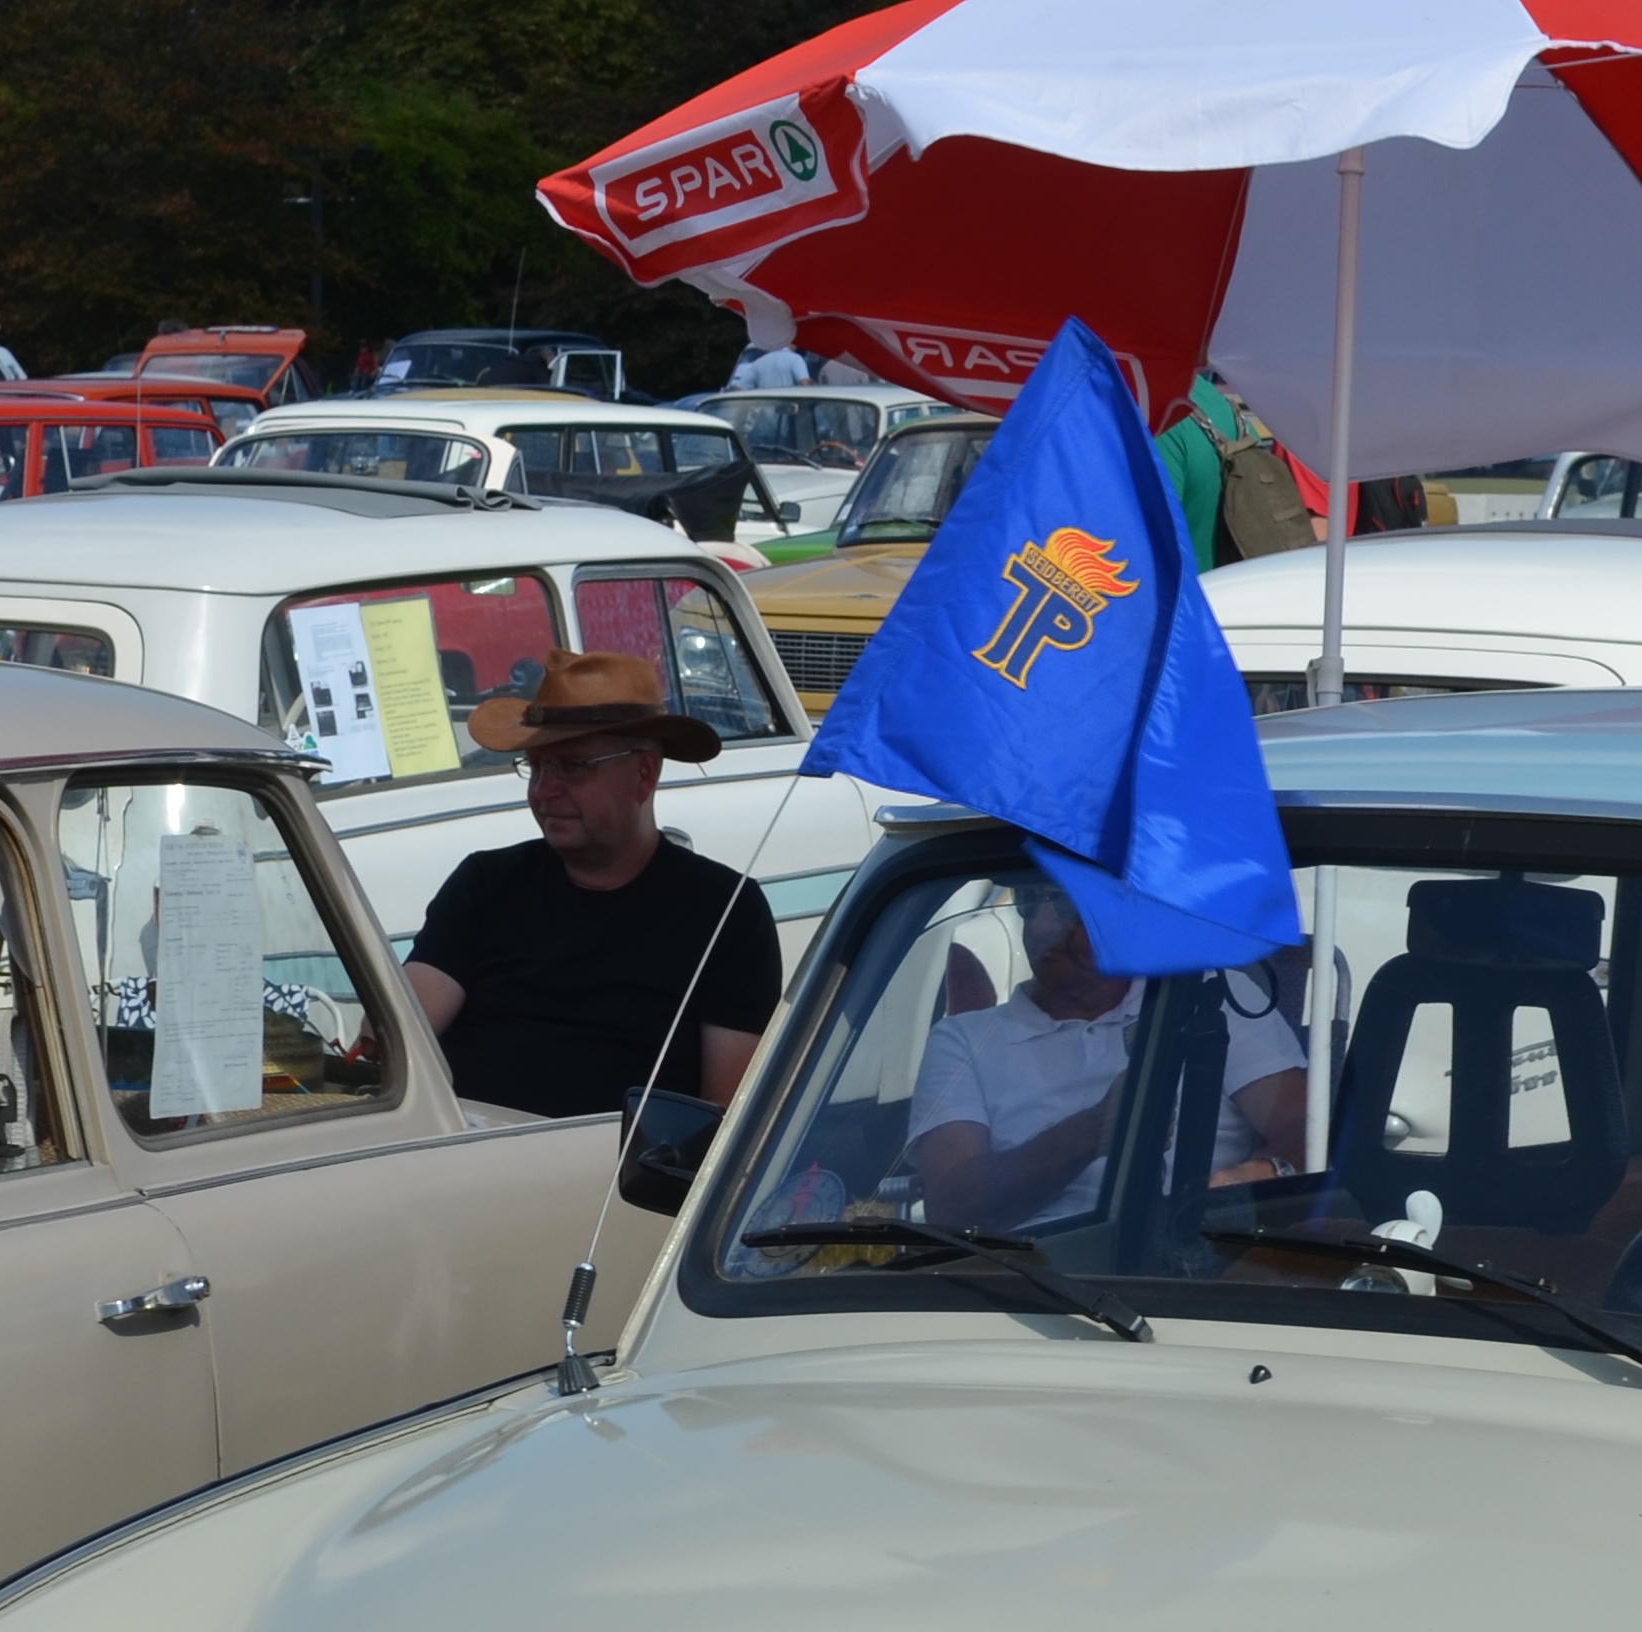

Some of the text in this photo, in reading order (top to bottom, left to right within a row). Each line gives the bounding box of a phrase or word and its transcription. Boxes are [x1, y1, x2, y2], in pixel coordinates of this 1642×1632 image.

[635, 144, 772, 221] SPAR
[1025, 547, 1099, 612] SEID BEREIT
